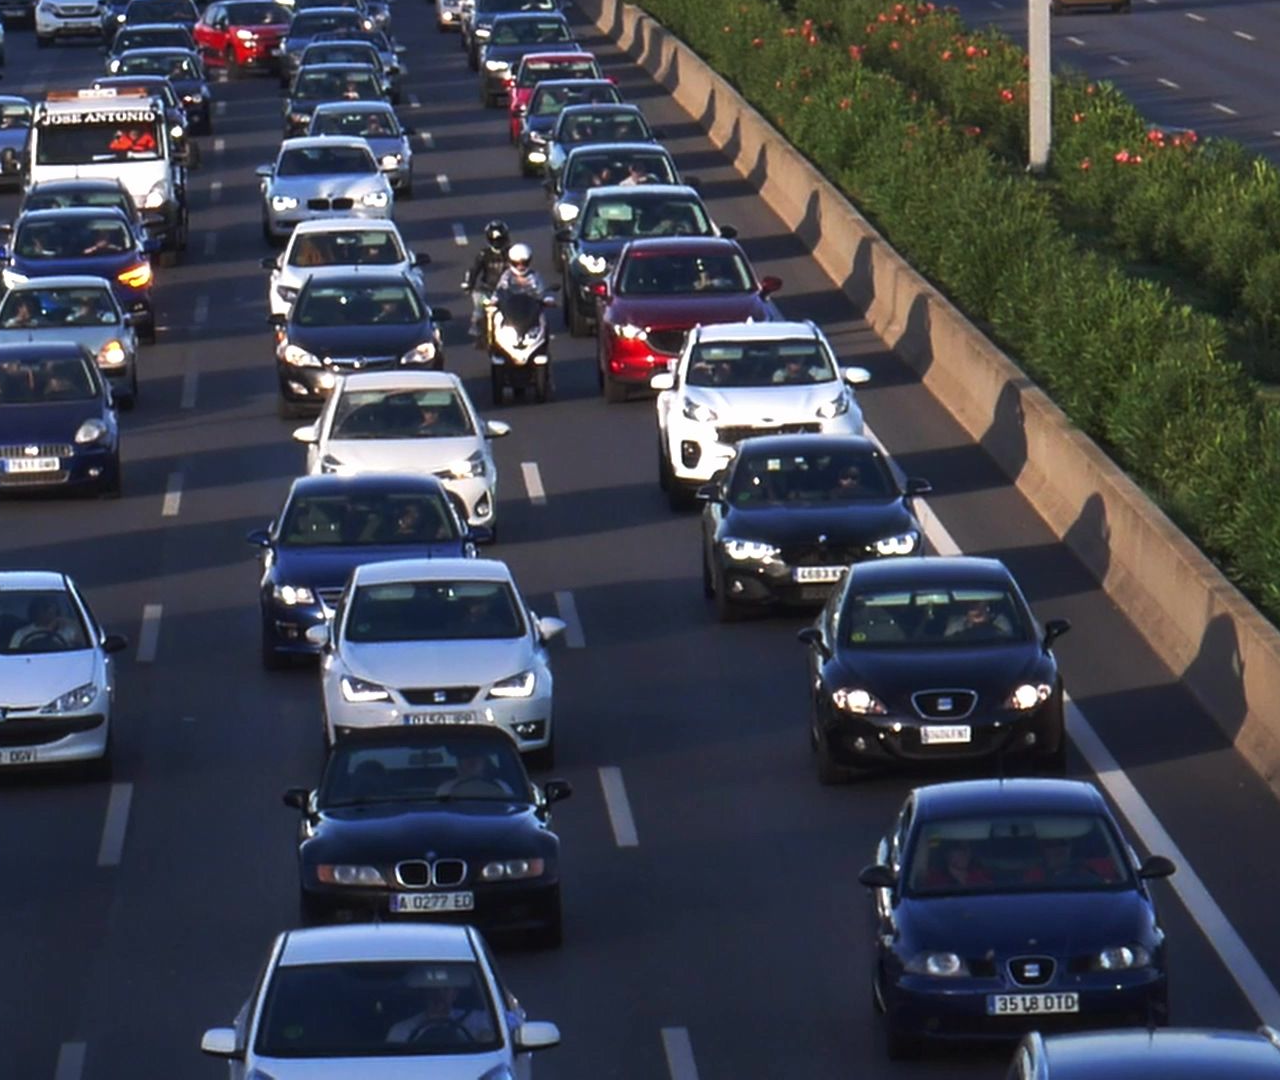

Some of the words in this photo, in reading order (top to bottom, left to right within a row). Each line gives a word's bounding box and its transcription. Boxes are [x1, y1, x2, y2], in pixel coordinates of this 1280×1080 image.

[42, 112, 82, 125] JOSE
[84, 110, 156, 124] ANTONIO
[413, 895, 448, 910] 0277
[998, 996, 1039, 1013] 3518
[1043, 995, 1076, 1011] DTD
